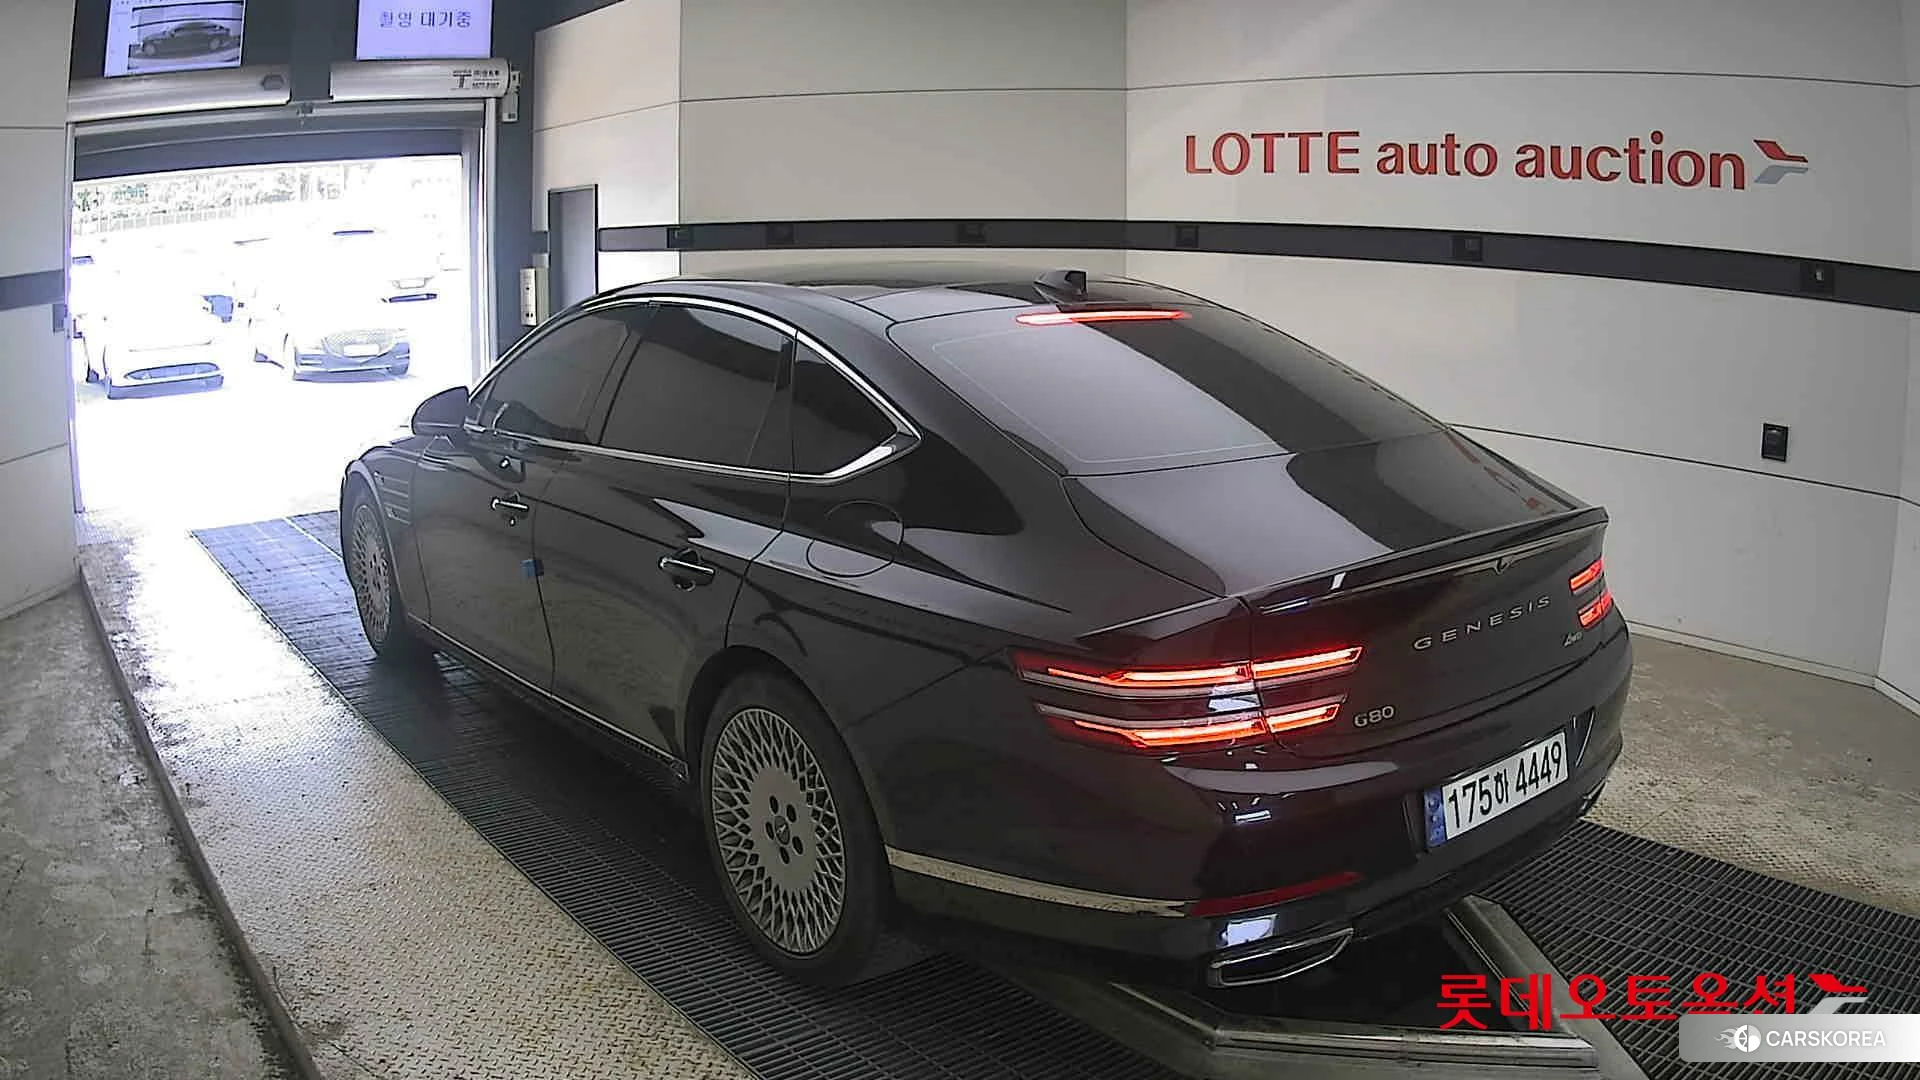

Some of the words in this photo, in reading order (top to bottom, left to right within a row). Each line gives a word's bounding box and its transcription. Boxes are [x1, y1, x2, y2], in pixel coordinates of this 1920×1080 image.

[420, 11, 471, 28] 대기중
[1186, 131, 1360, 175] LOTTE
[1376, 133, 1498, 177] auto
[1515, 131, 1744, 190] auction
[1413, 596, 1549, 650] GENESIS
[1354, 705, 1395, 727] G80
[1449, 768, 1509, 828] 175하
[1516, 741, 1562, 796] 4449
